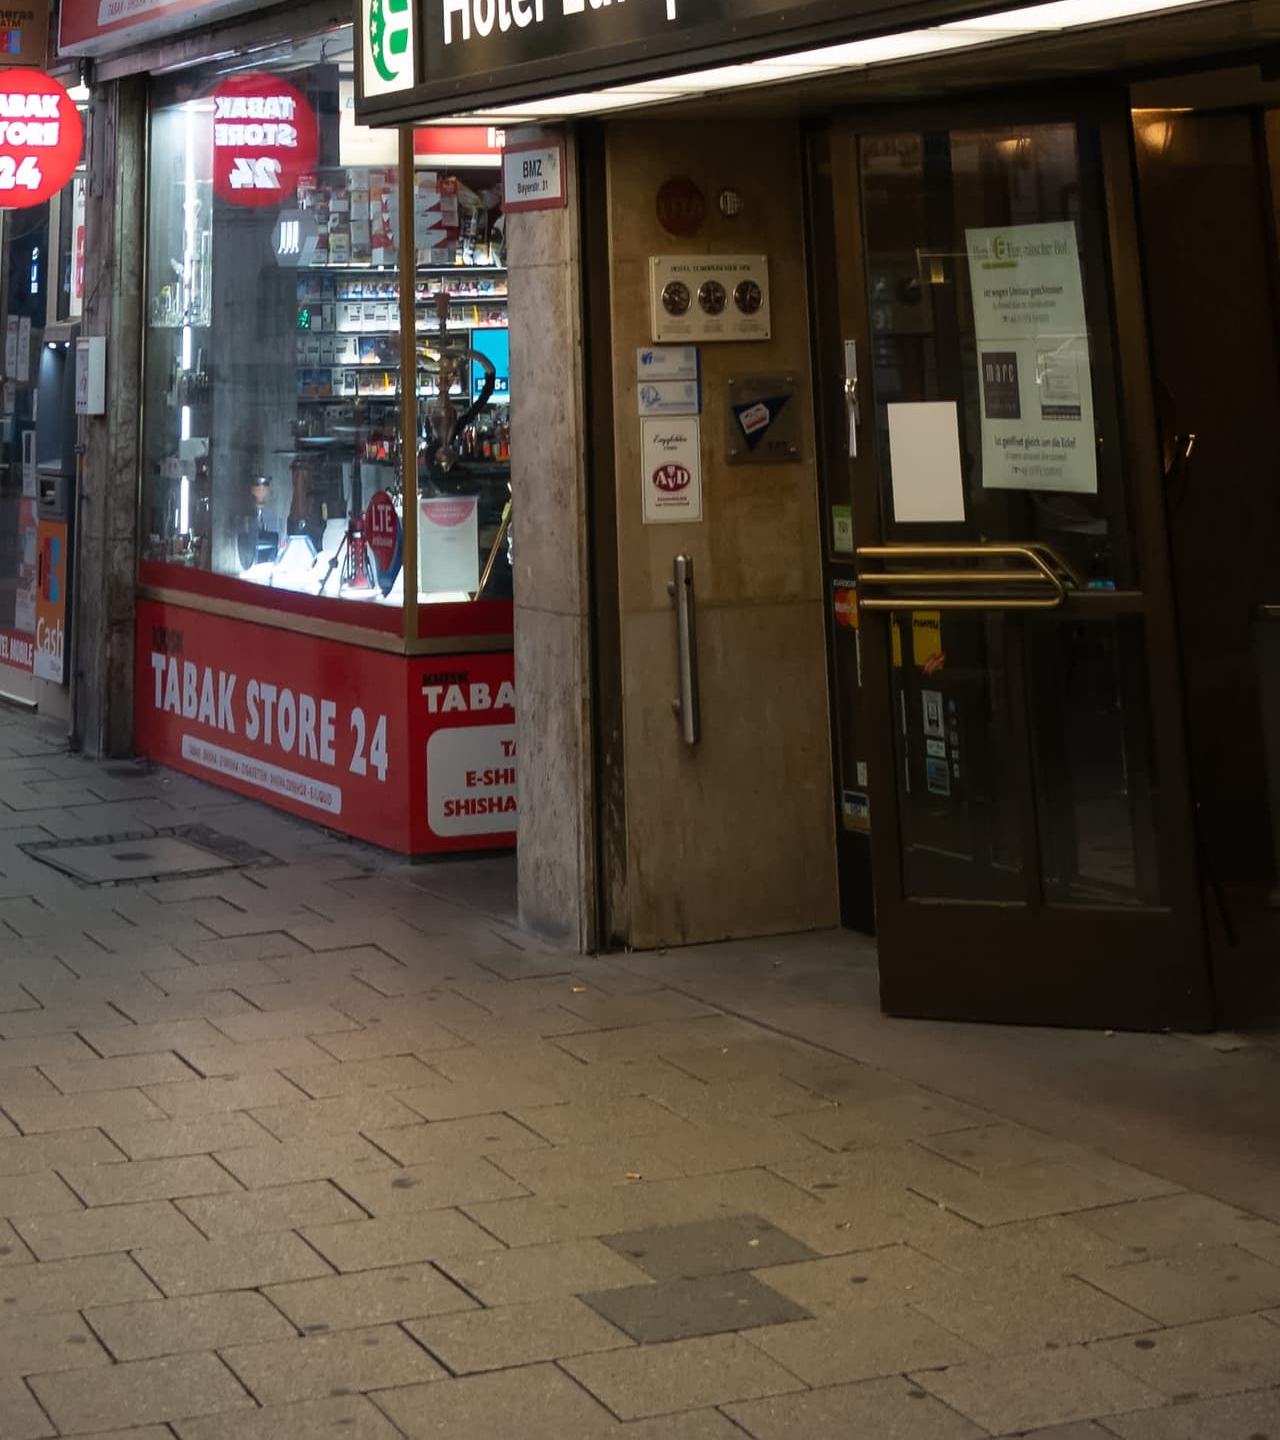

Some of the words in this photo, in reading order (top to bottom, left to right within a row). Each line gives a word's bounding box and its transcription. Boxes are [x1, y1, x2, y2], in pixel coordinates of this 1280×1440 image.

[522, 159, 543, 179] BMZ
[371, 504, 392, 533] LTE
[36, 617, 64, 658] Cash
[151, 651, 237, 734] TABAK
[246, 678, 337, 766] STORE
[348, 706, 389, 782] 24
